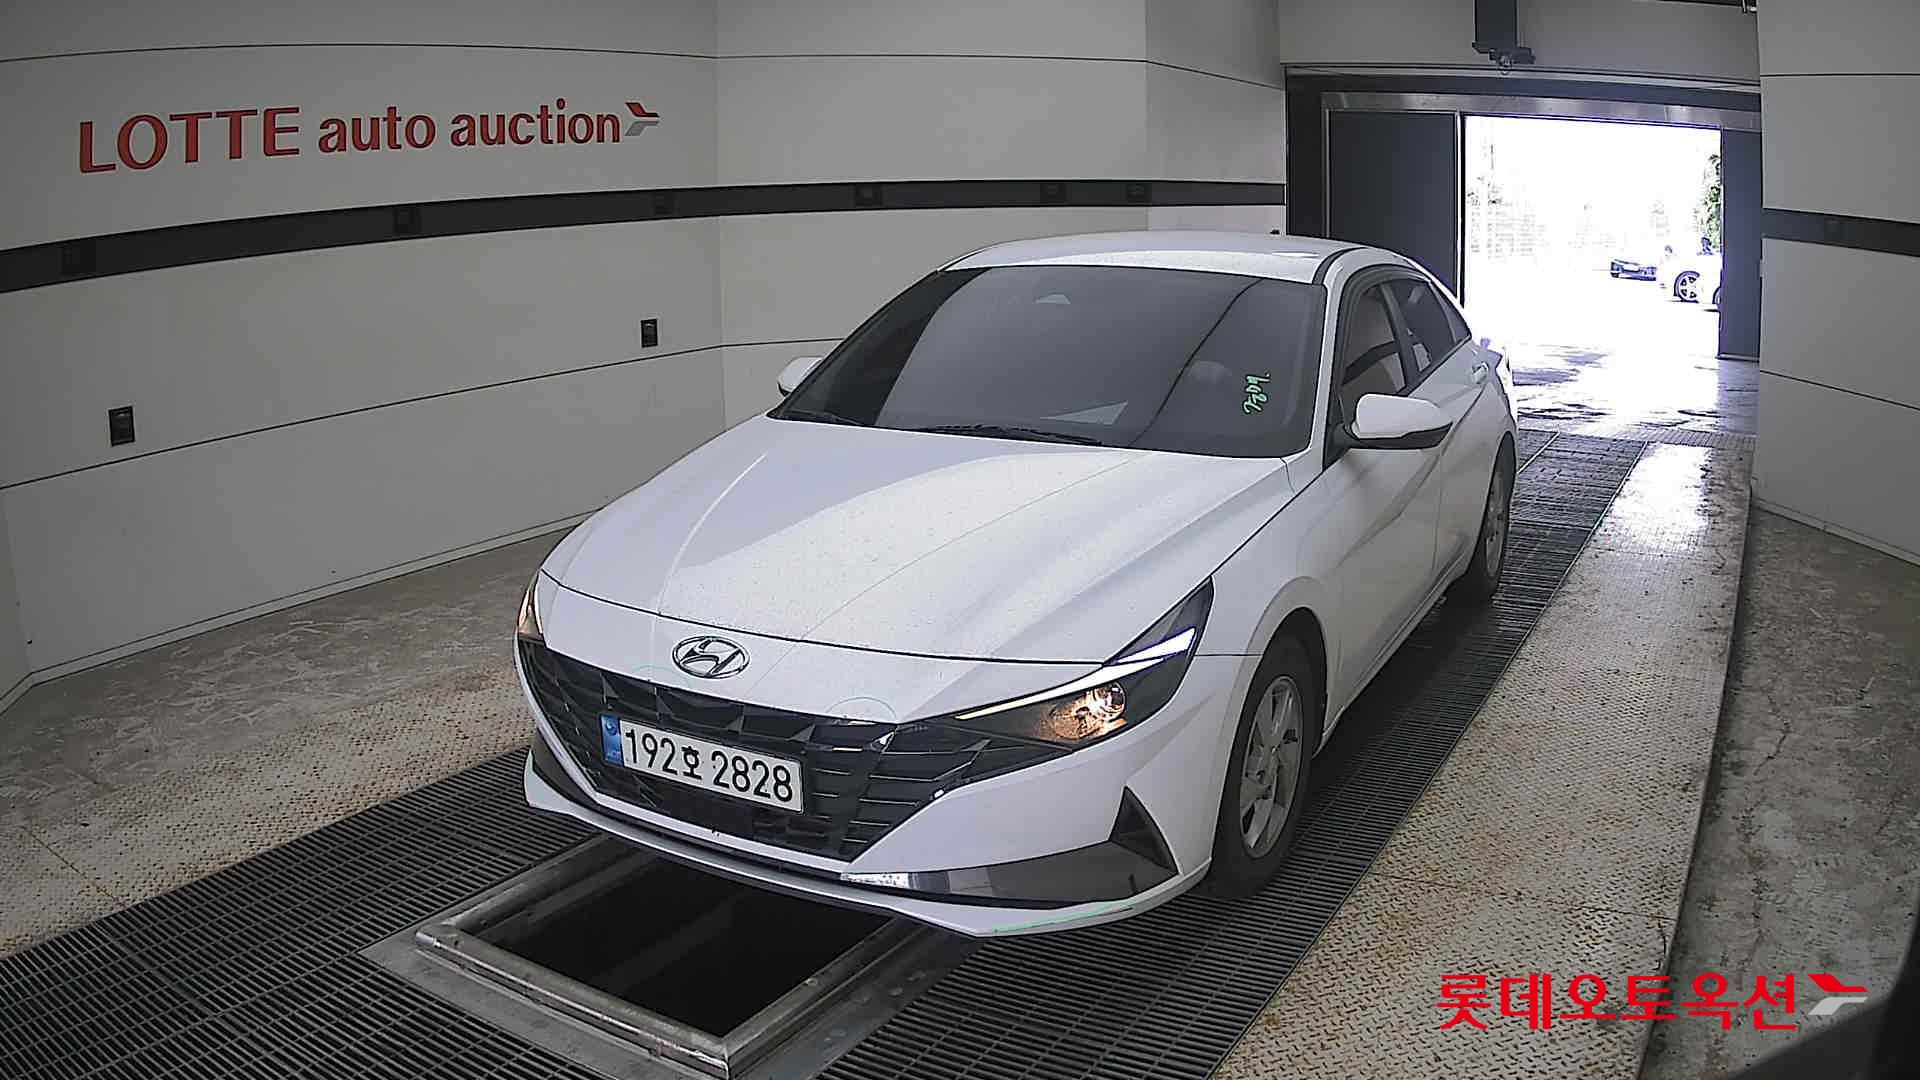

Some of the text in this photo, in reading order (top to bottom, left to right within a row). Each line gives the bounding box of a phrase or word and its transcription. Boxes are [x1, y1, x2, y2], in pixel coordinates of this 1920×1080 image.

[79, 98, 622, 173] LOTTE auto auction
[624, 727, 794, 802] 192호 2828
